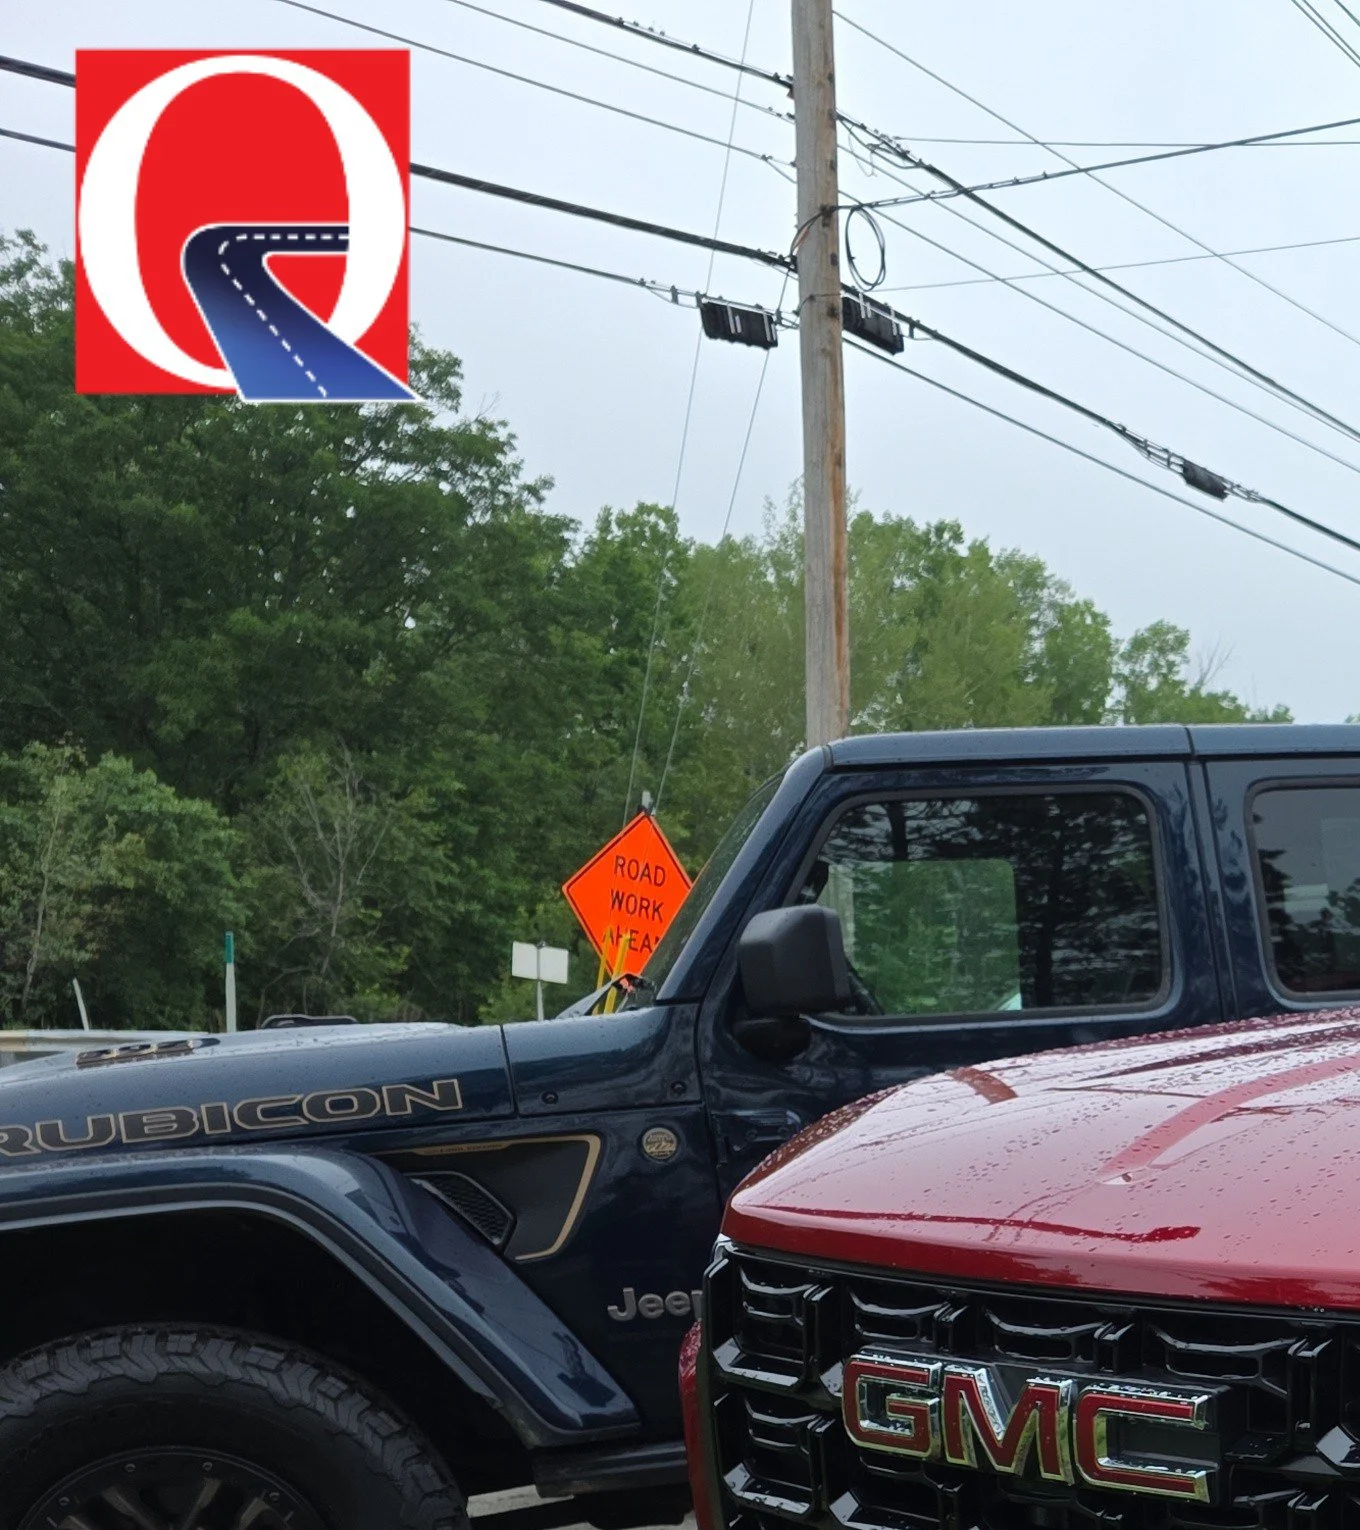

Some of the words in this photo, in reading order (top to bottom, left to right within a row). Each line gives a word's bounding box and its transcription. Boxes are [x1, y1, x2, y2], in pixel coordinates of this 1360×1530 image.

[614, 855, 666, 887] ROAD
[610, 889, 665, 924] WORK
[602, 924, 660, 954] AHEA
[0, 1078, 464, 1158] RUBICON
[841, 1347, 1219, 1503] GMC
